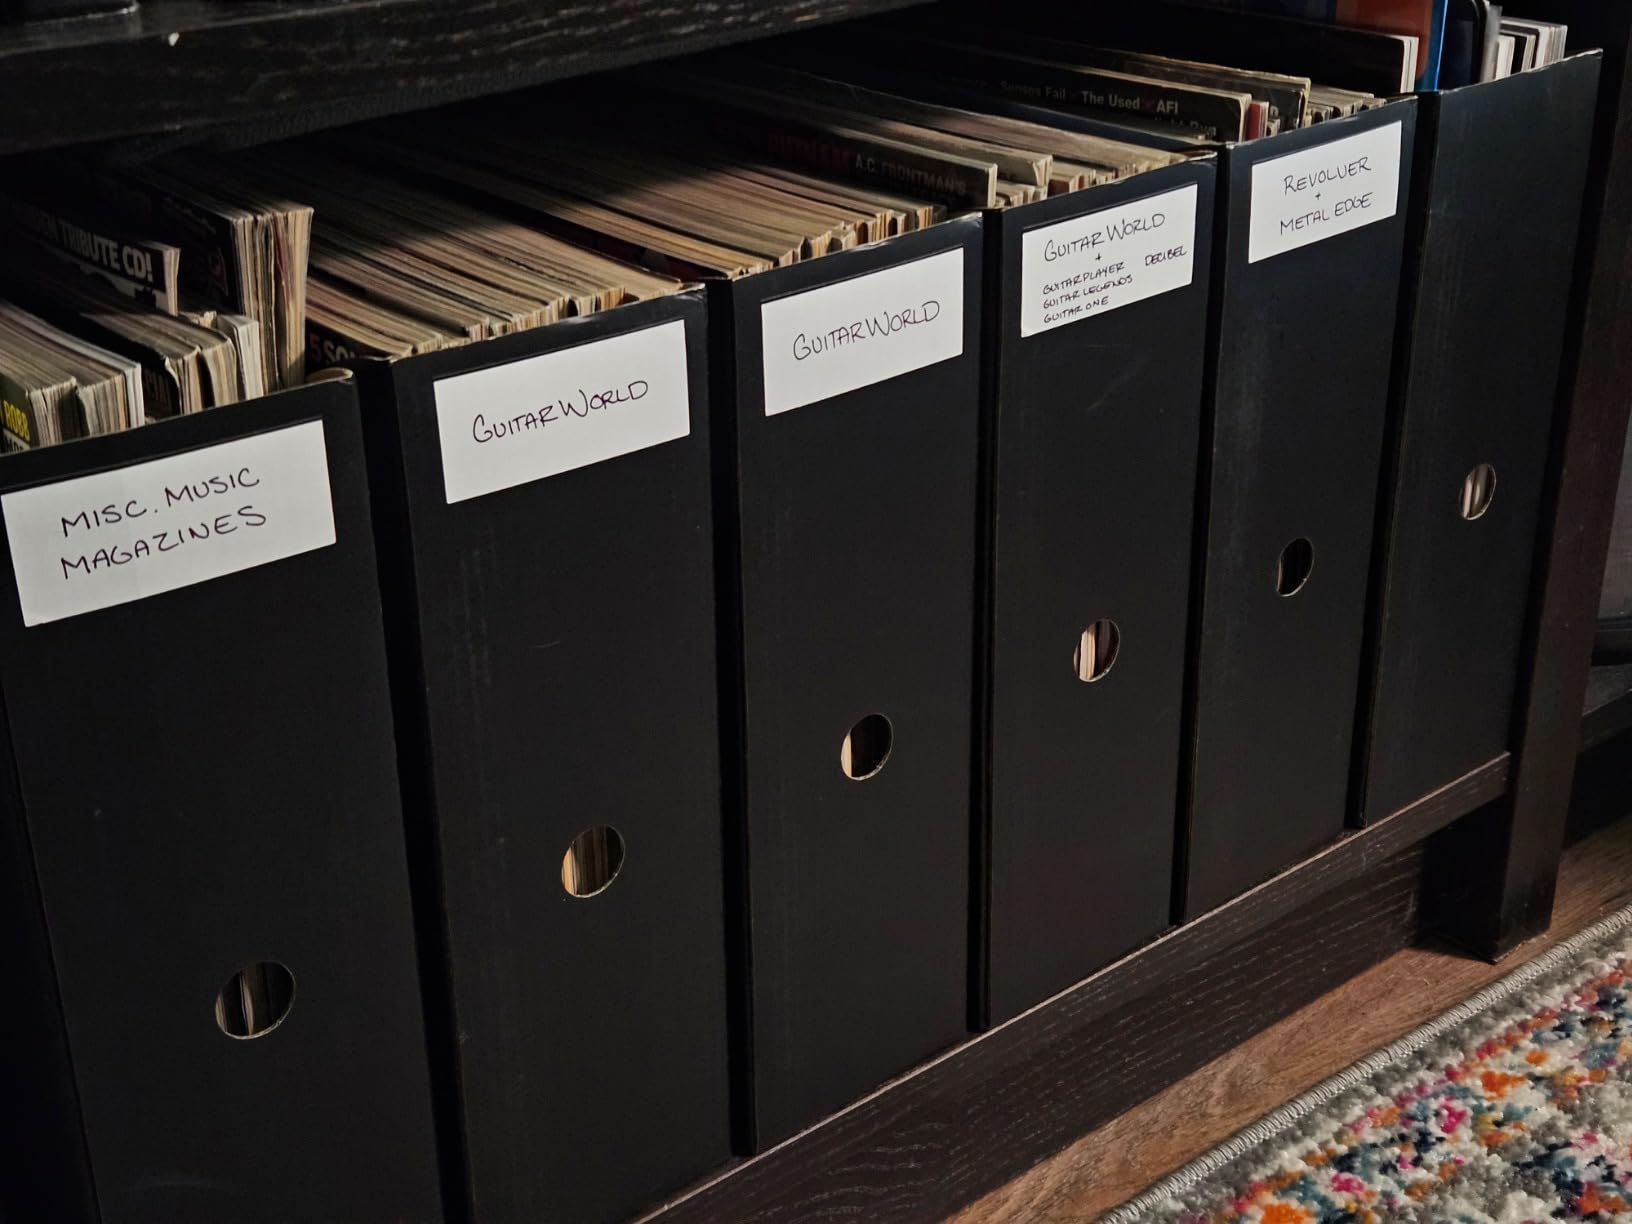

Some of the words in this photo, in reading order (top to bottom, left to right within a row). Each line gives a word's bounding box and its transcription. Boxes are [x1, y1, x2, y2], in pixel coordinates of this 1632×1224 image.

[1081, 90, 1104, 105] The
[1108, 93, 1141, 110] Used
[1155, 99, 1179, 115] AFI
[1280, 208, 1330, 236] METAL
[1334, 192, 1374, 217] EDGE
[57, 218, 121, 272] TRIBUTE
[122, 244, 155, 284] CD!
[1043, 231, 1105, 262] GUITAR
[1105, 213, 1166, 242] WORLD
[1143, 245, 1188, 267] DECIBEL
[1043, 290, 1081, 310] GUITAR
[1083, 273, 1134, 296] LEGENDS
[1043, 305, 1083, 324] GUITAR
[1085, 295, 1110, 311] ONE
[61, 500, 159, 538] MISC.
[164, 467, 261, 507] MUSIC
[60, 505, 267, 580] MAGAZINES
